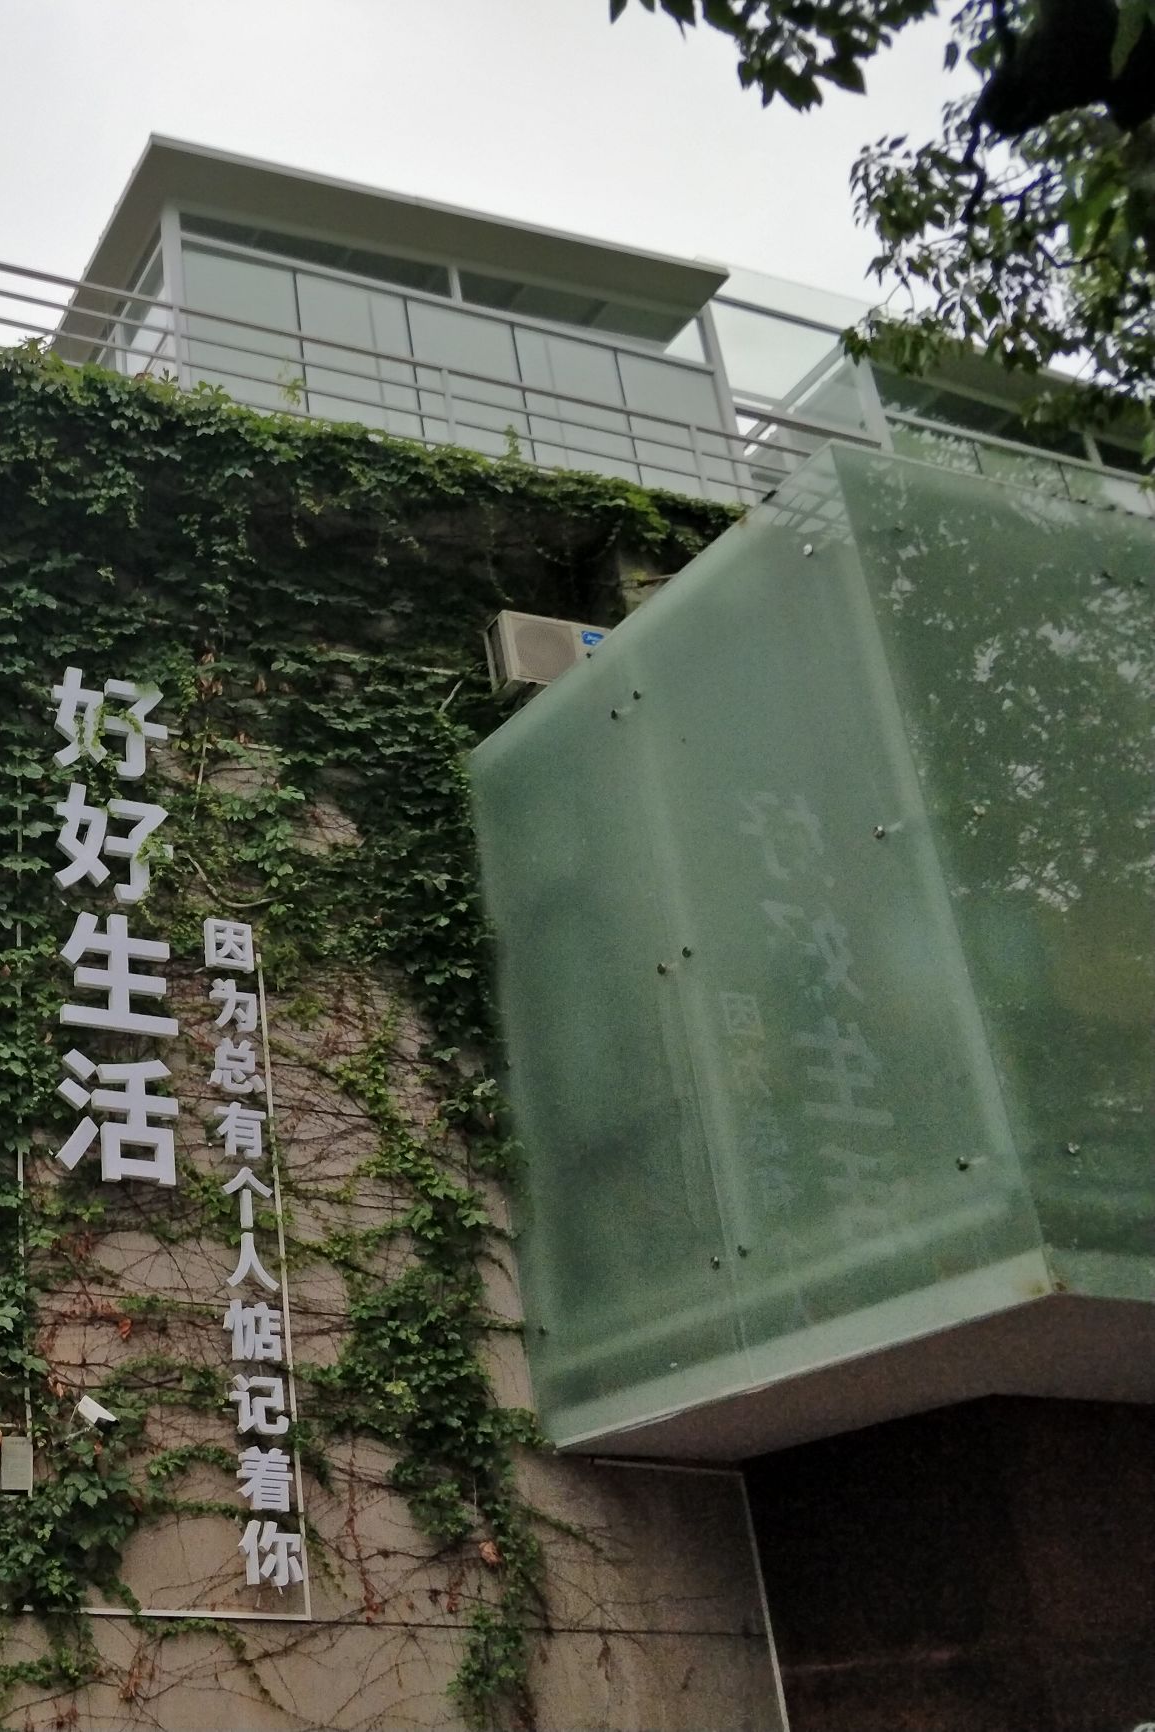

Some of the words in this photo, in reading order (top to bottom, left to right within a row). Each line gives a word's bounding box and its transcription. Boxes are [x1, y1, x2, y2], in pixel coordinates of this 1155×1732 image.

[51, 666, 179, 1187] 好好生活
[203, 917, 304, 1588] 因为总有个人惦记着你
